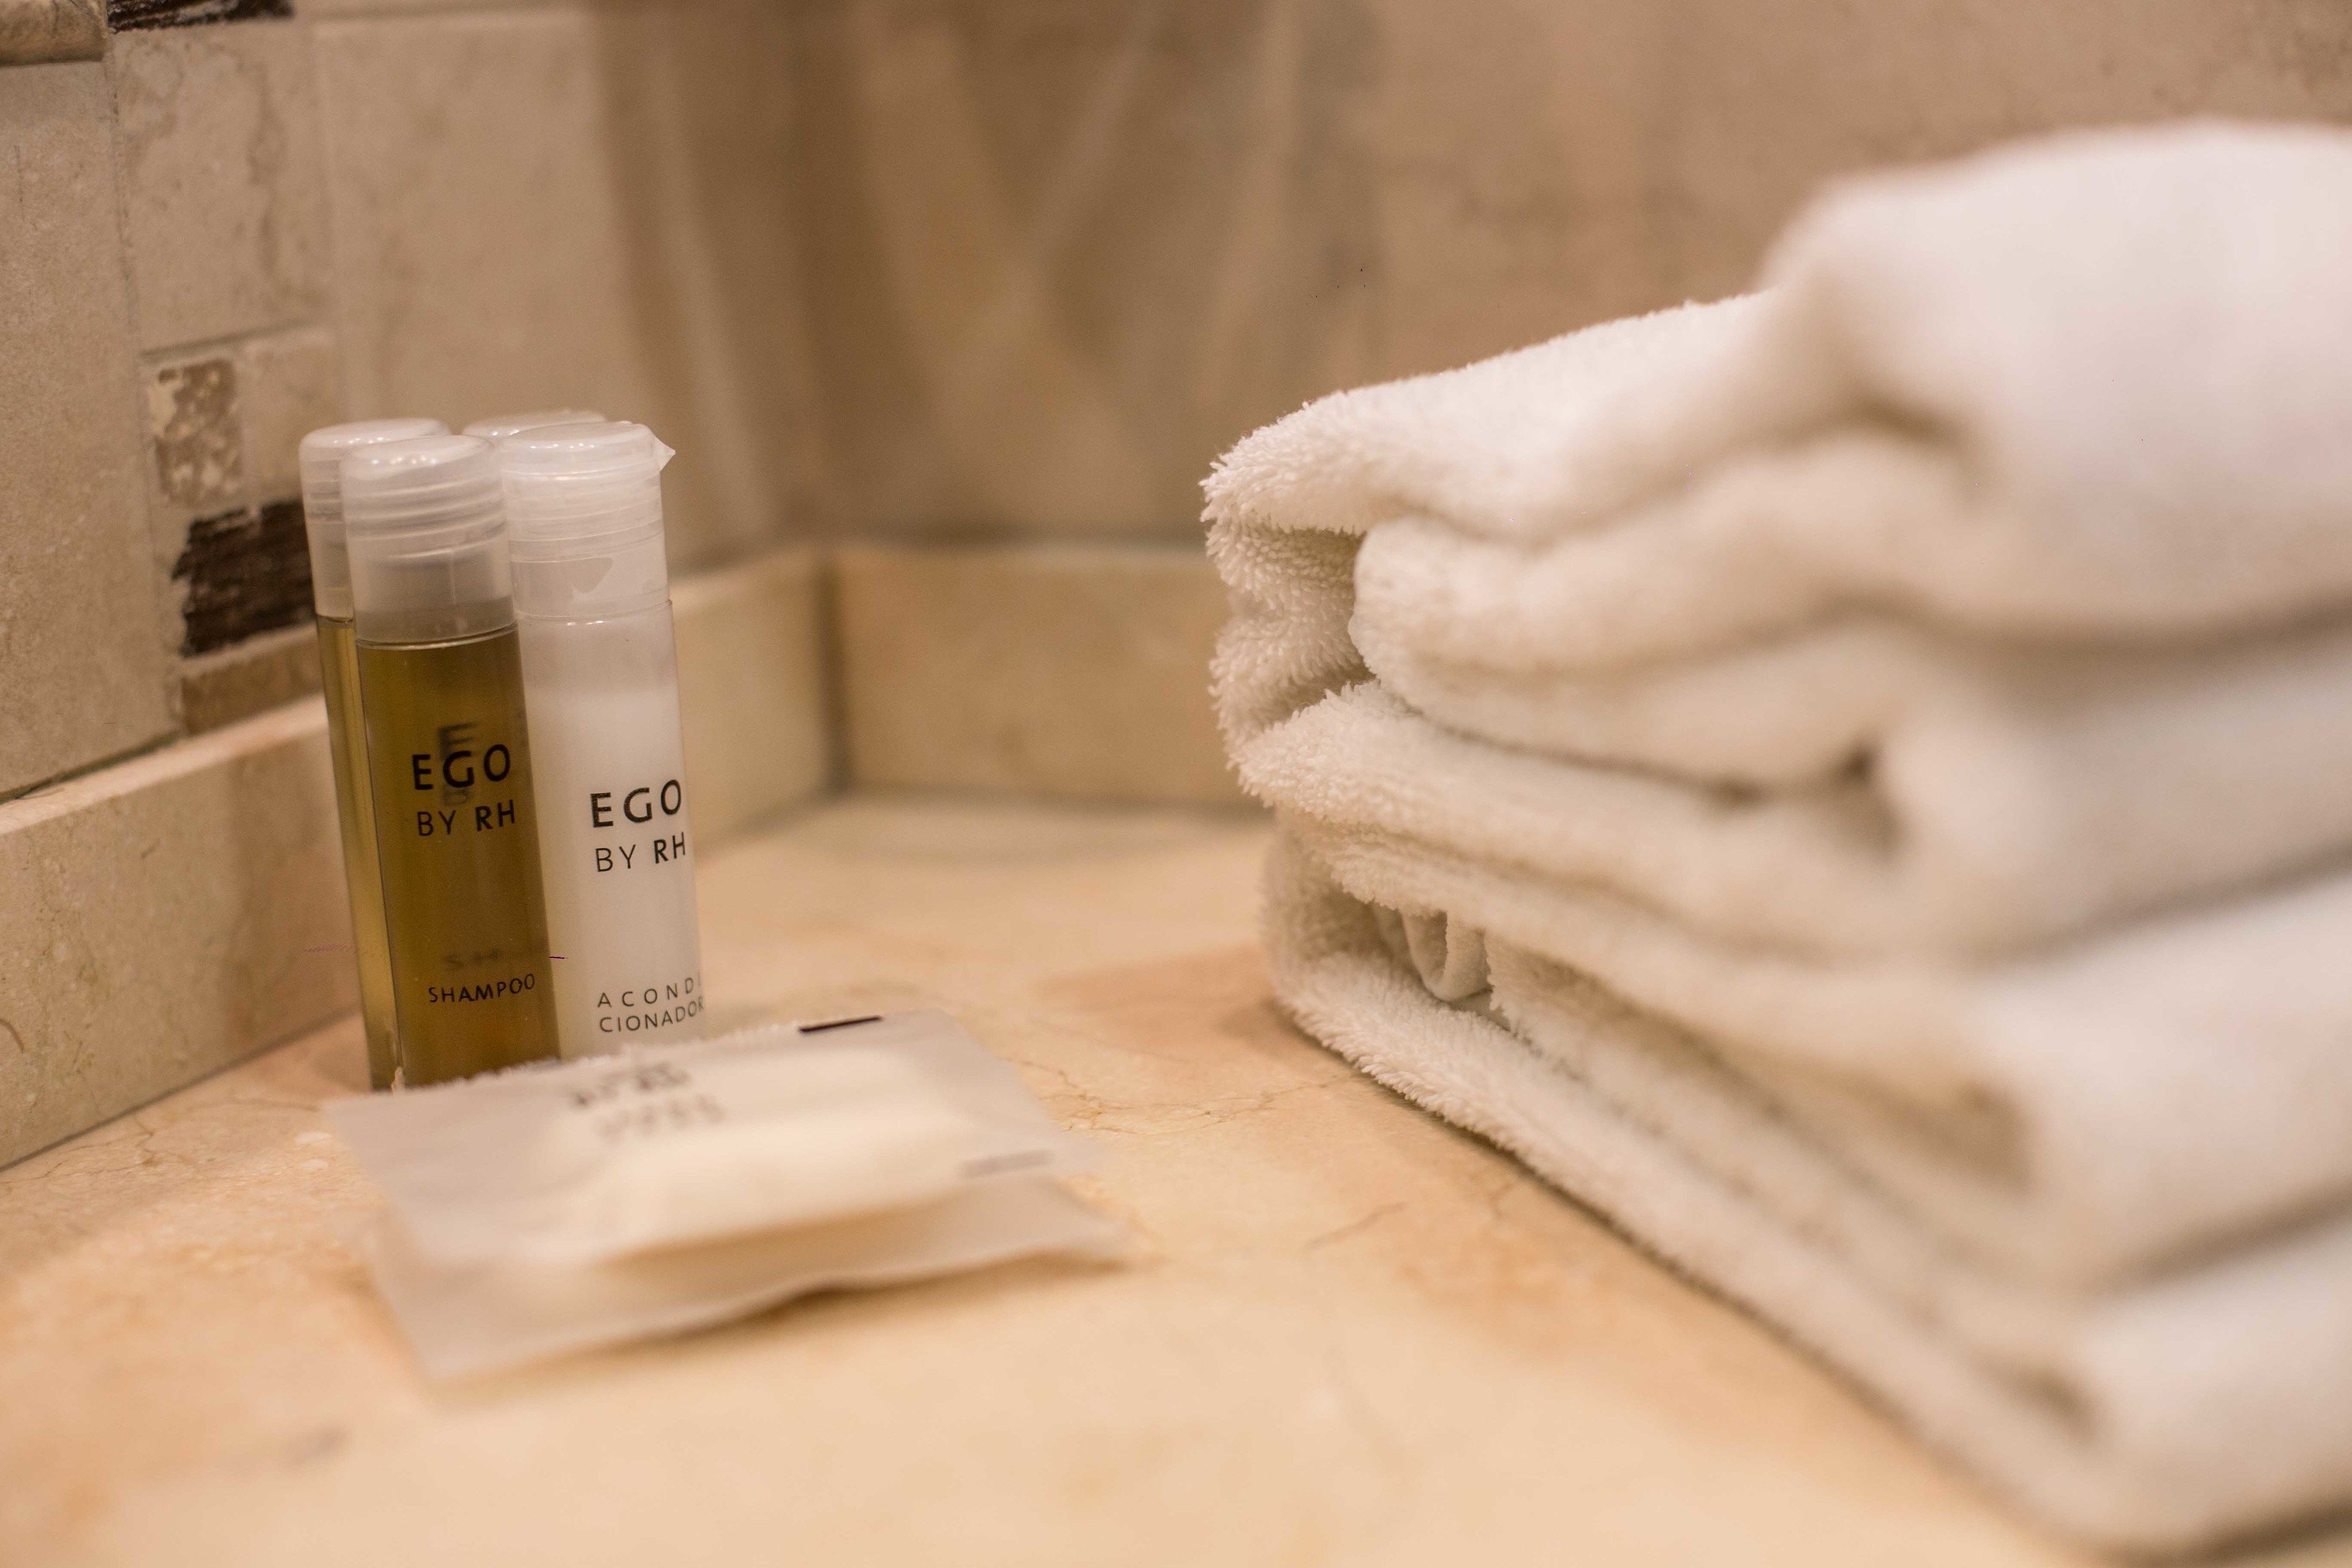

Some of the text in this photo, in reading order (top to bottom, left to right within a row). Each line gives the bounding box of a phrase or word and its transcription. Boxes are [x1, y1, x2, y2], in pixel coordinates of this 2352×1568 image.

[412, 744, 511, 790] EGO
[417, 799, 516, 837] BY RH
[590, 779, 682, 828] EGO
[595, 831, 685, 872] BY RH
[429, 973, 535, 1003] SHAMPOO
